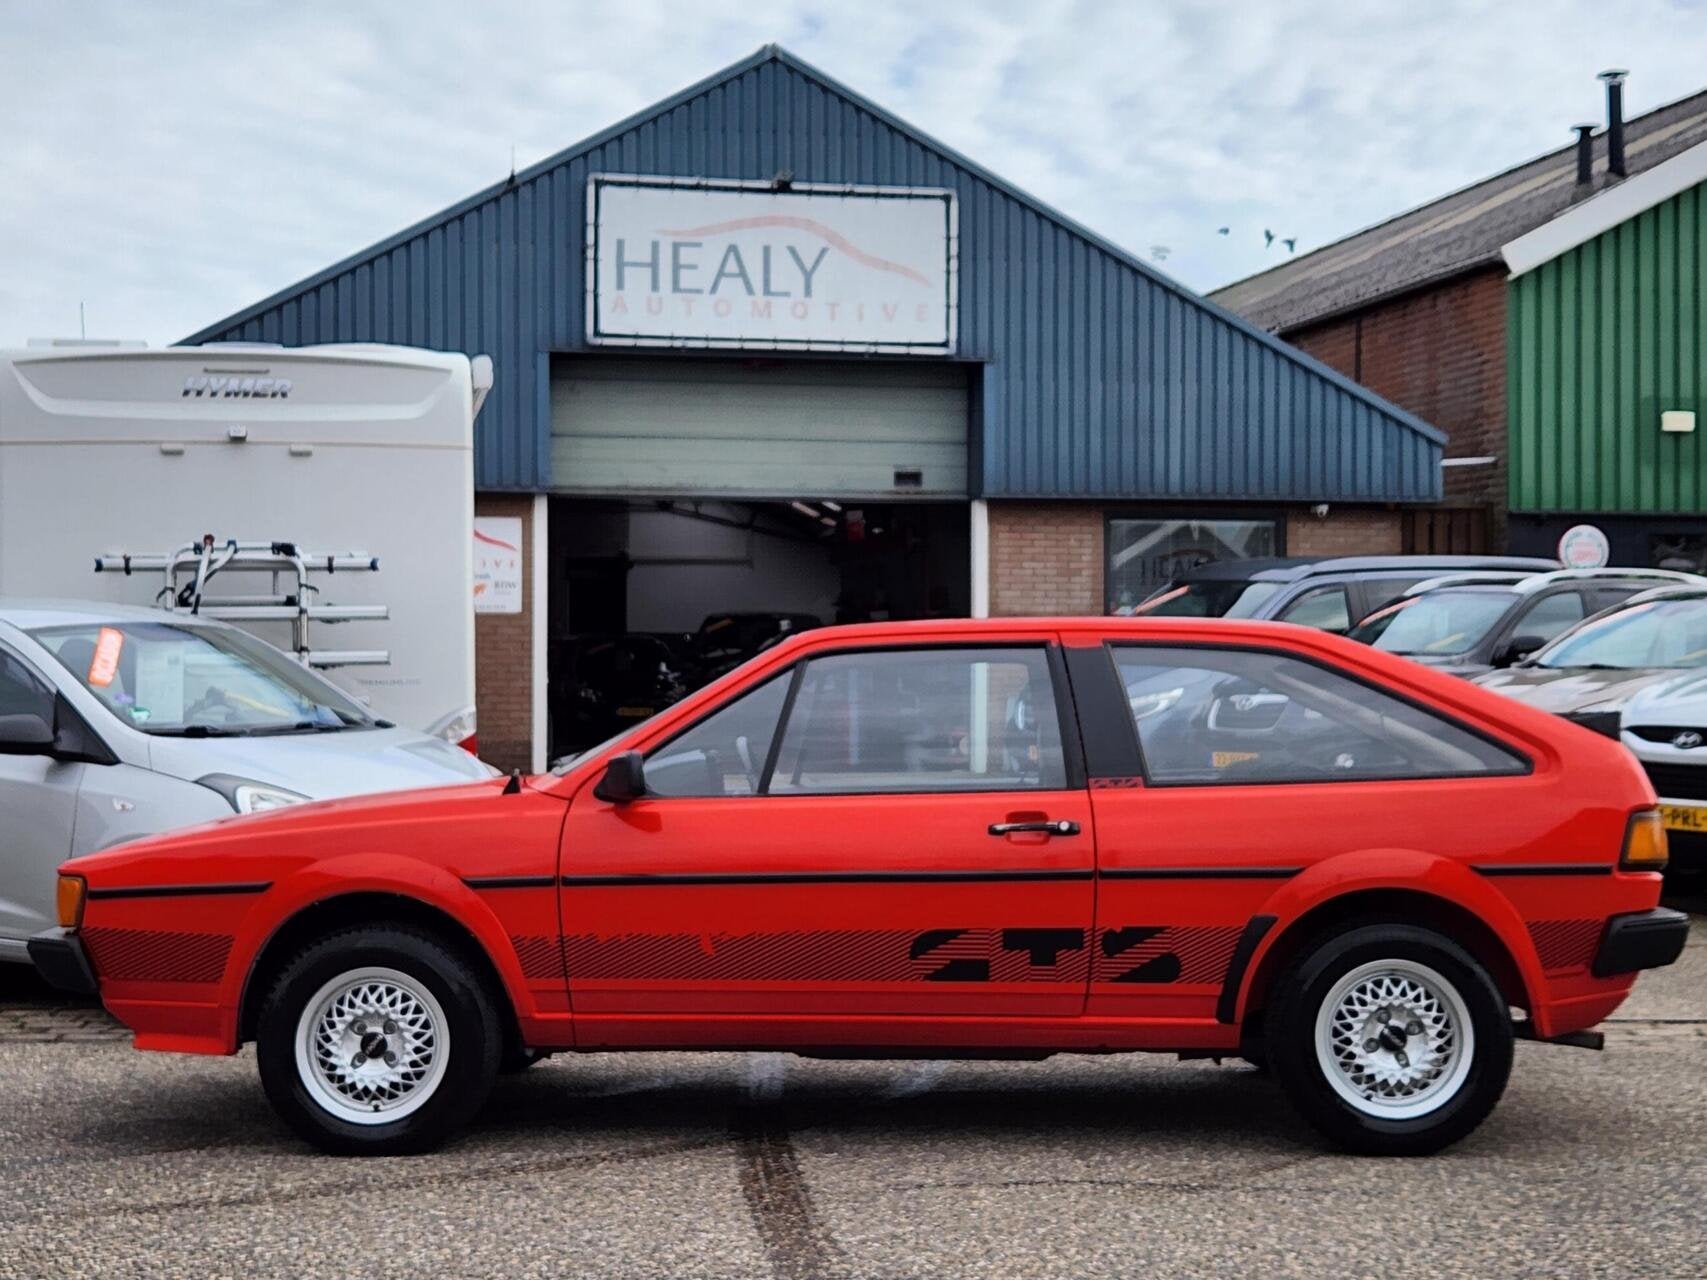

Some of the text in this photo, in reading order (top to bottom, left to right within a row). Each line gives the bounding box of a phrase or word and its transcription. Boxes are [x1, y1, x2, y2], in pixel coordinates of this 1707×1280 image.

[615, 238, 830, 298] HEALY
[611, 295, 930, 323] AUTOMOTIVE
[182, 376, 292, 398] HYMER
